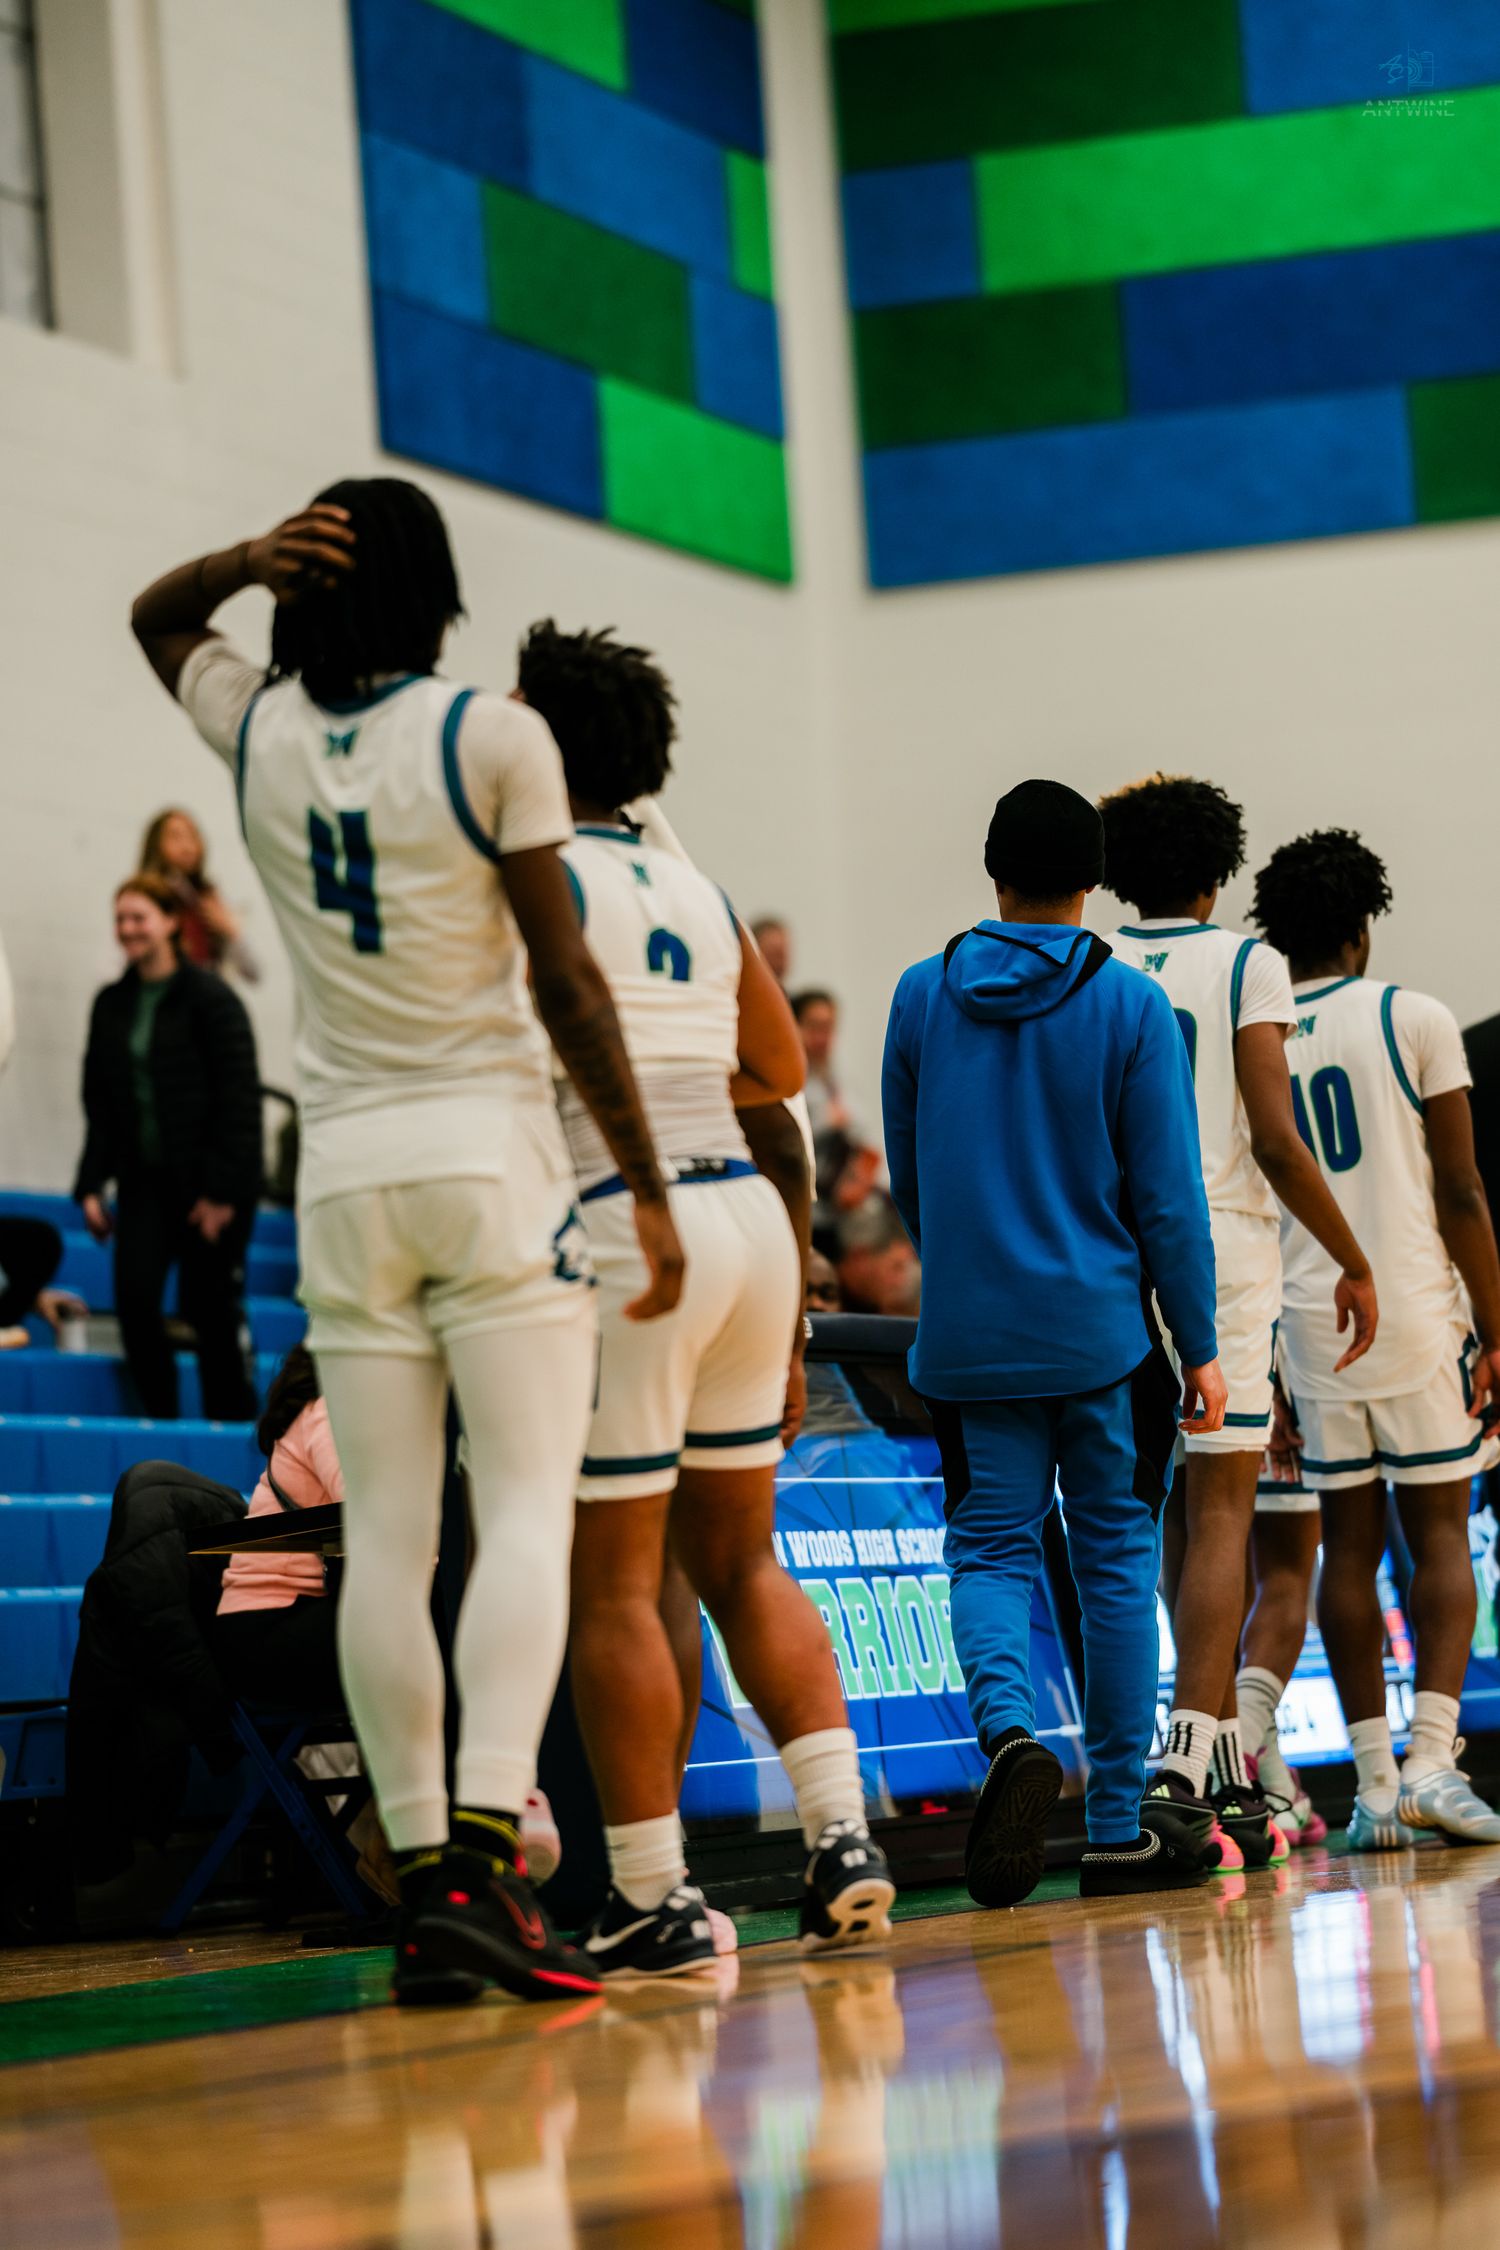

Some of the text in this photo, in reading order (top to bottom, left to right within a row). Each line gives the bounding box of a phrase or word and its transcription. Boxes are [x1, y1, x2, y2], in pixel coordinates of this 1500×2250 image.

[307, 806, 385, 955] 4
[785, 1529, 856, 1568] WOODS
[851, 1528, 899, 1566] HIGH
